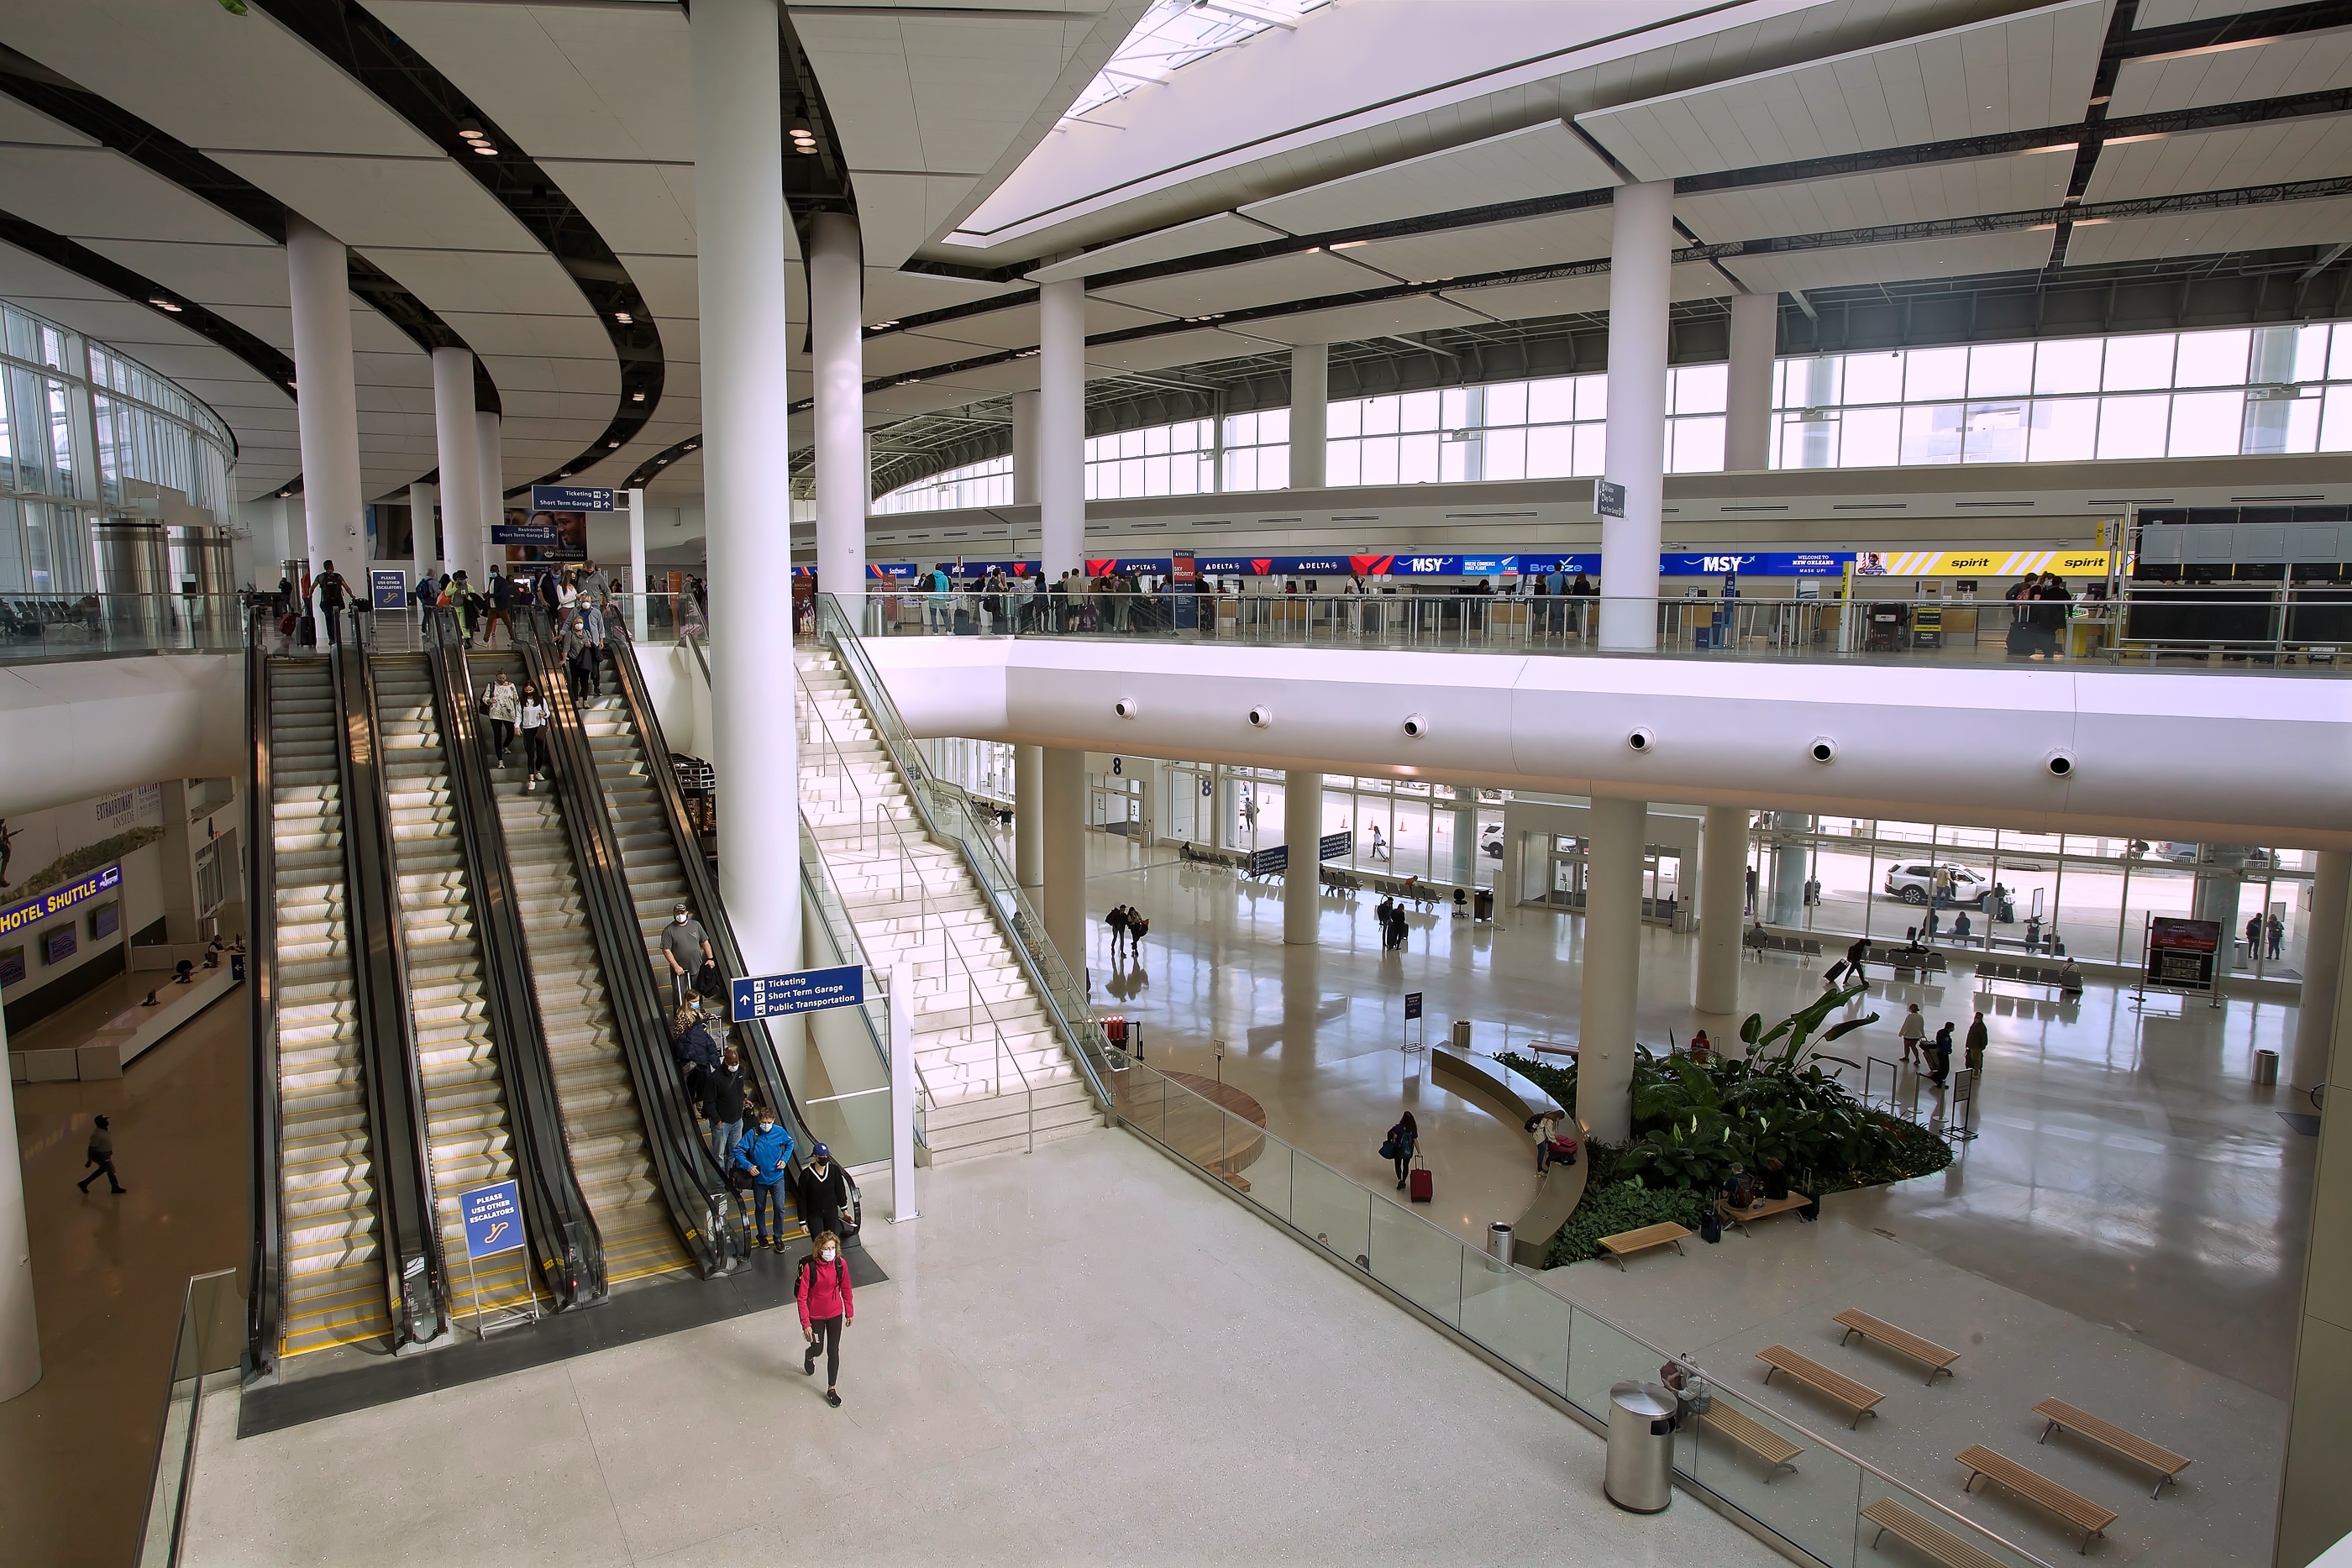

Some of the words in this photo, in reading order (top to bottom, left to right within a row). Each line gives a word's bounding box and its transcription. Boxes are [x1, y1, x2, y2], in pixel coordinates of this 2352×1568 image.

[1412, 558, 1444, 572] MSY
[1530, 564, 1583, 572] Breze
[1704, 556, 1743, 572] MSY
[1950, 558, 1990, 569] spirit
[2064, 558, 2106, 569] spirit
[1113, 757, 1122, 775] 8
[1201, 780, 1212, 797] 8
[97, 793, 134, 821] EXTRAORDINARY
[113, 810, 135, 829] INSIDE
[0, 904, 45, 934] HOTEL
[47, 879, 97, 913] SHUTTLE
[768, 978, 806, 989] Ticketing
[768, 992, 791, 1000] Short
[793, 989, 812, 997] Term
[815, 984, 843, 994] Garage
[769, 1003, 794, 1013] Public
[795, 994, 855, 1009] Transportation
[471, 1205, 486, 1214] USE
[486, 1199, 511, 1211] OTHER
[476, 1193, 503, 1205] PLEASE
[470, 1206, 515, 1224] ESCALATORS
